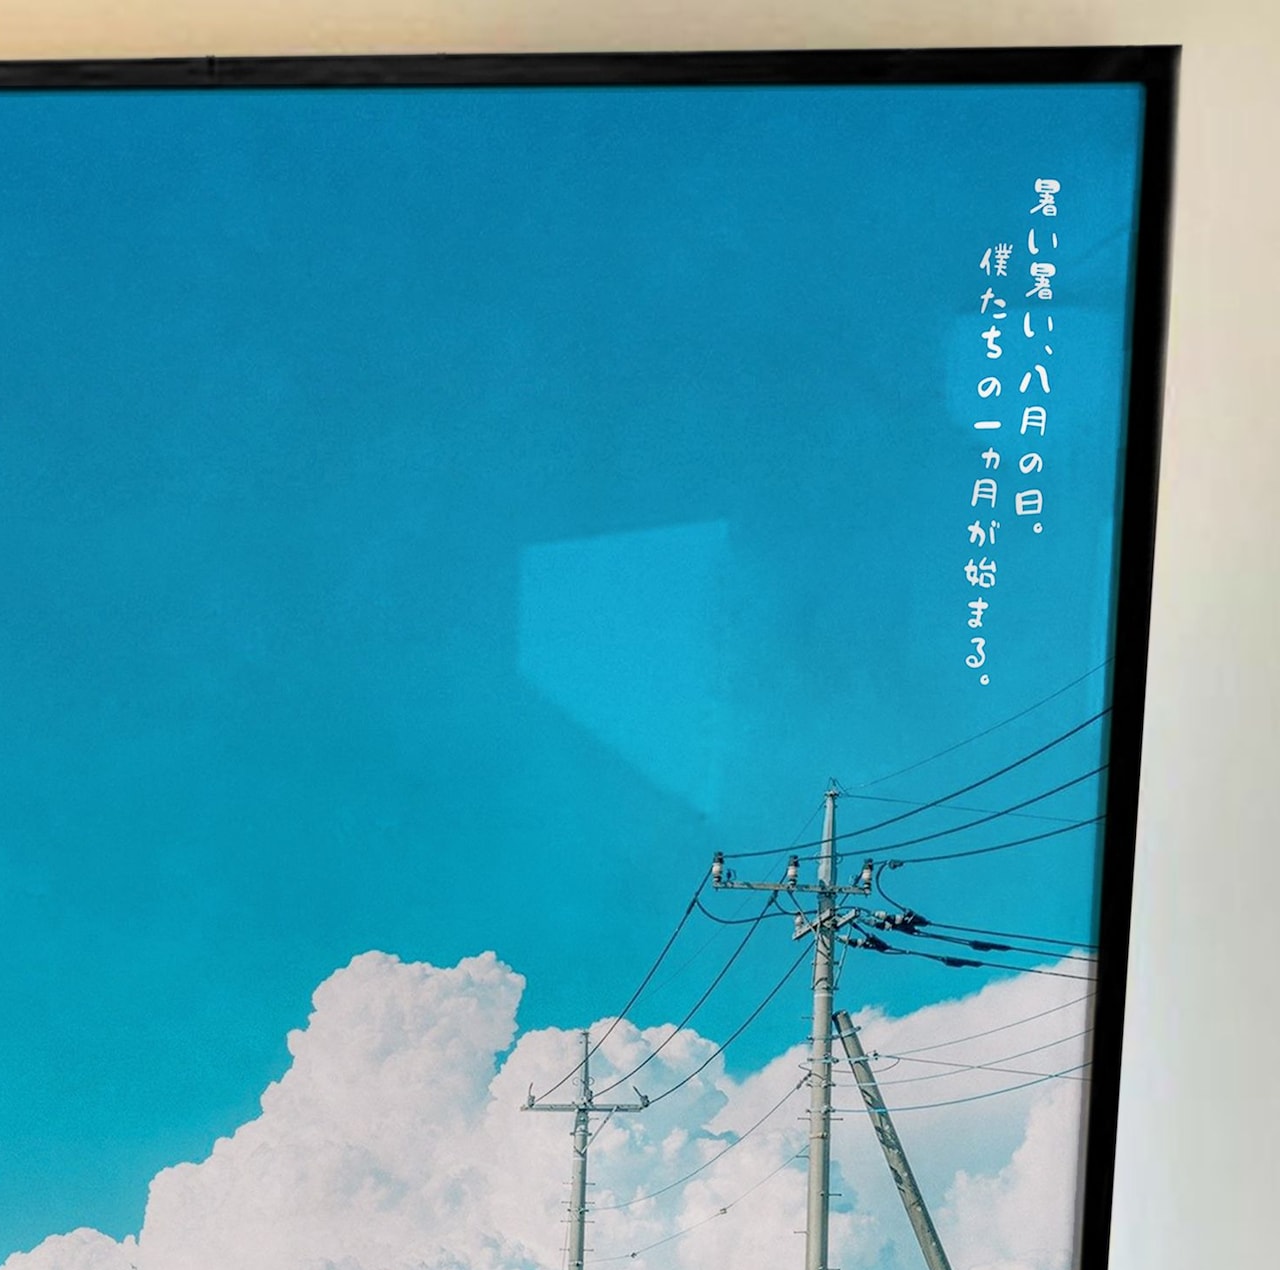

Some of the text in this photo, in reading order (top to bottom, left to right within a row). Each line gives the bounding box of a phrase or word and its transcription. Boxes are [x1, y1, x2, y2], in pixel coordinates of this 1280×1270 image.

[1015, 178, 1062, 534] 暑い暑い、八月の日。
